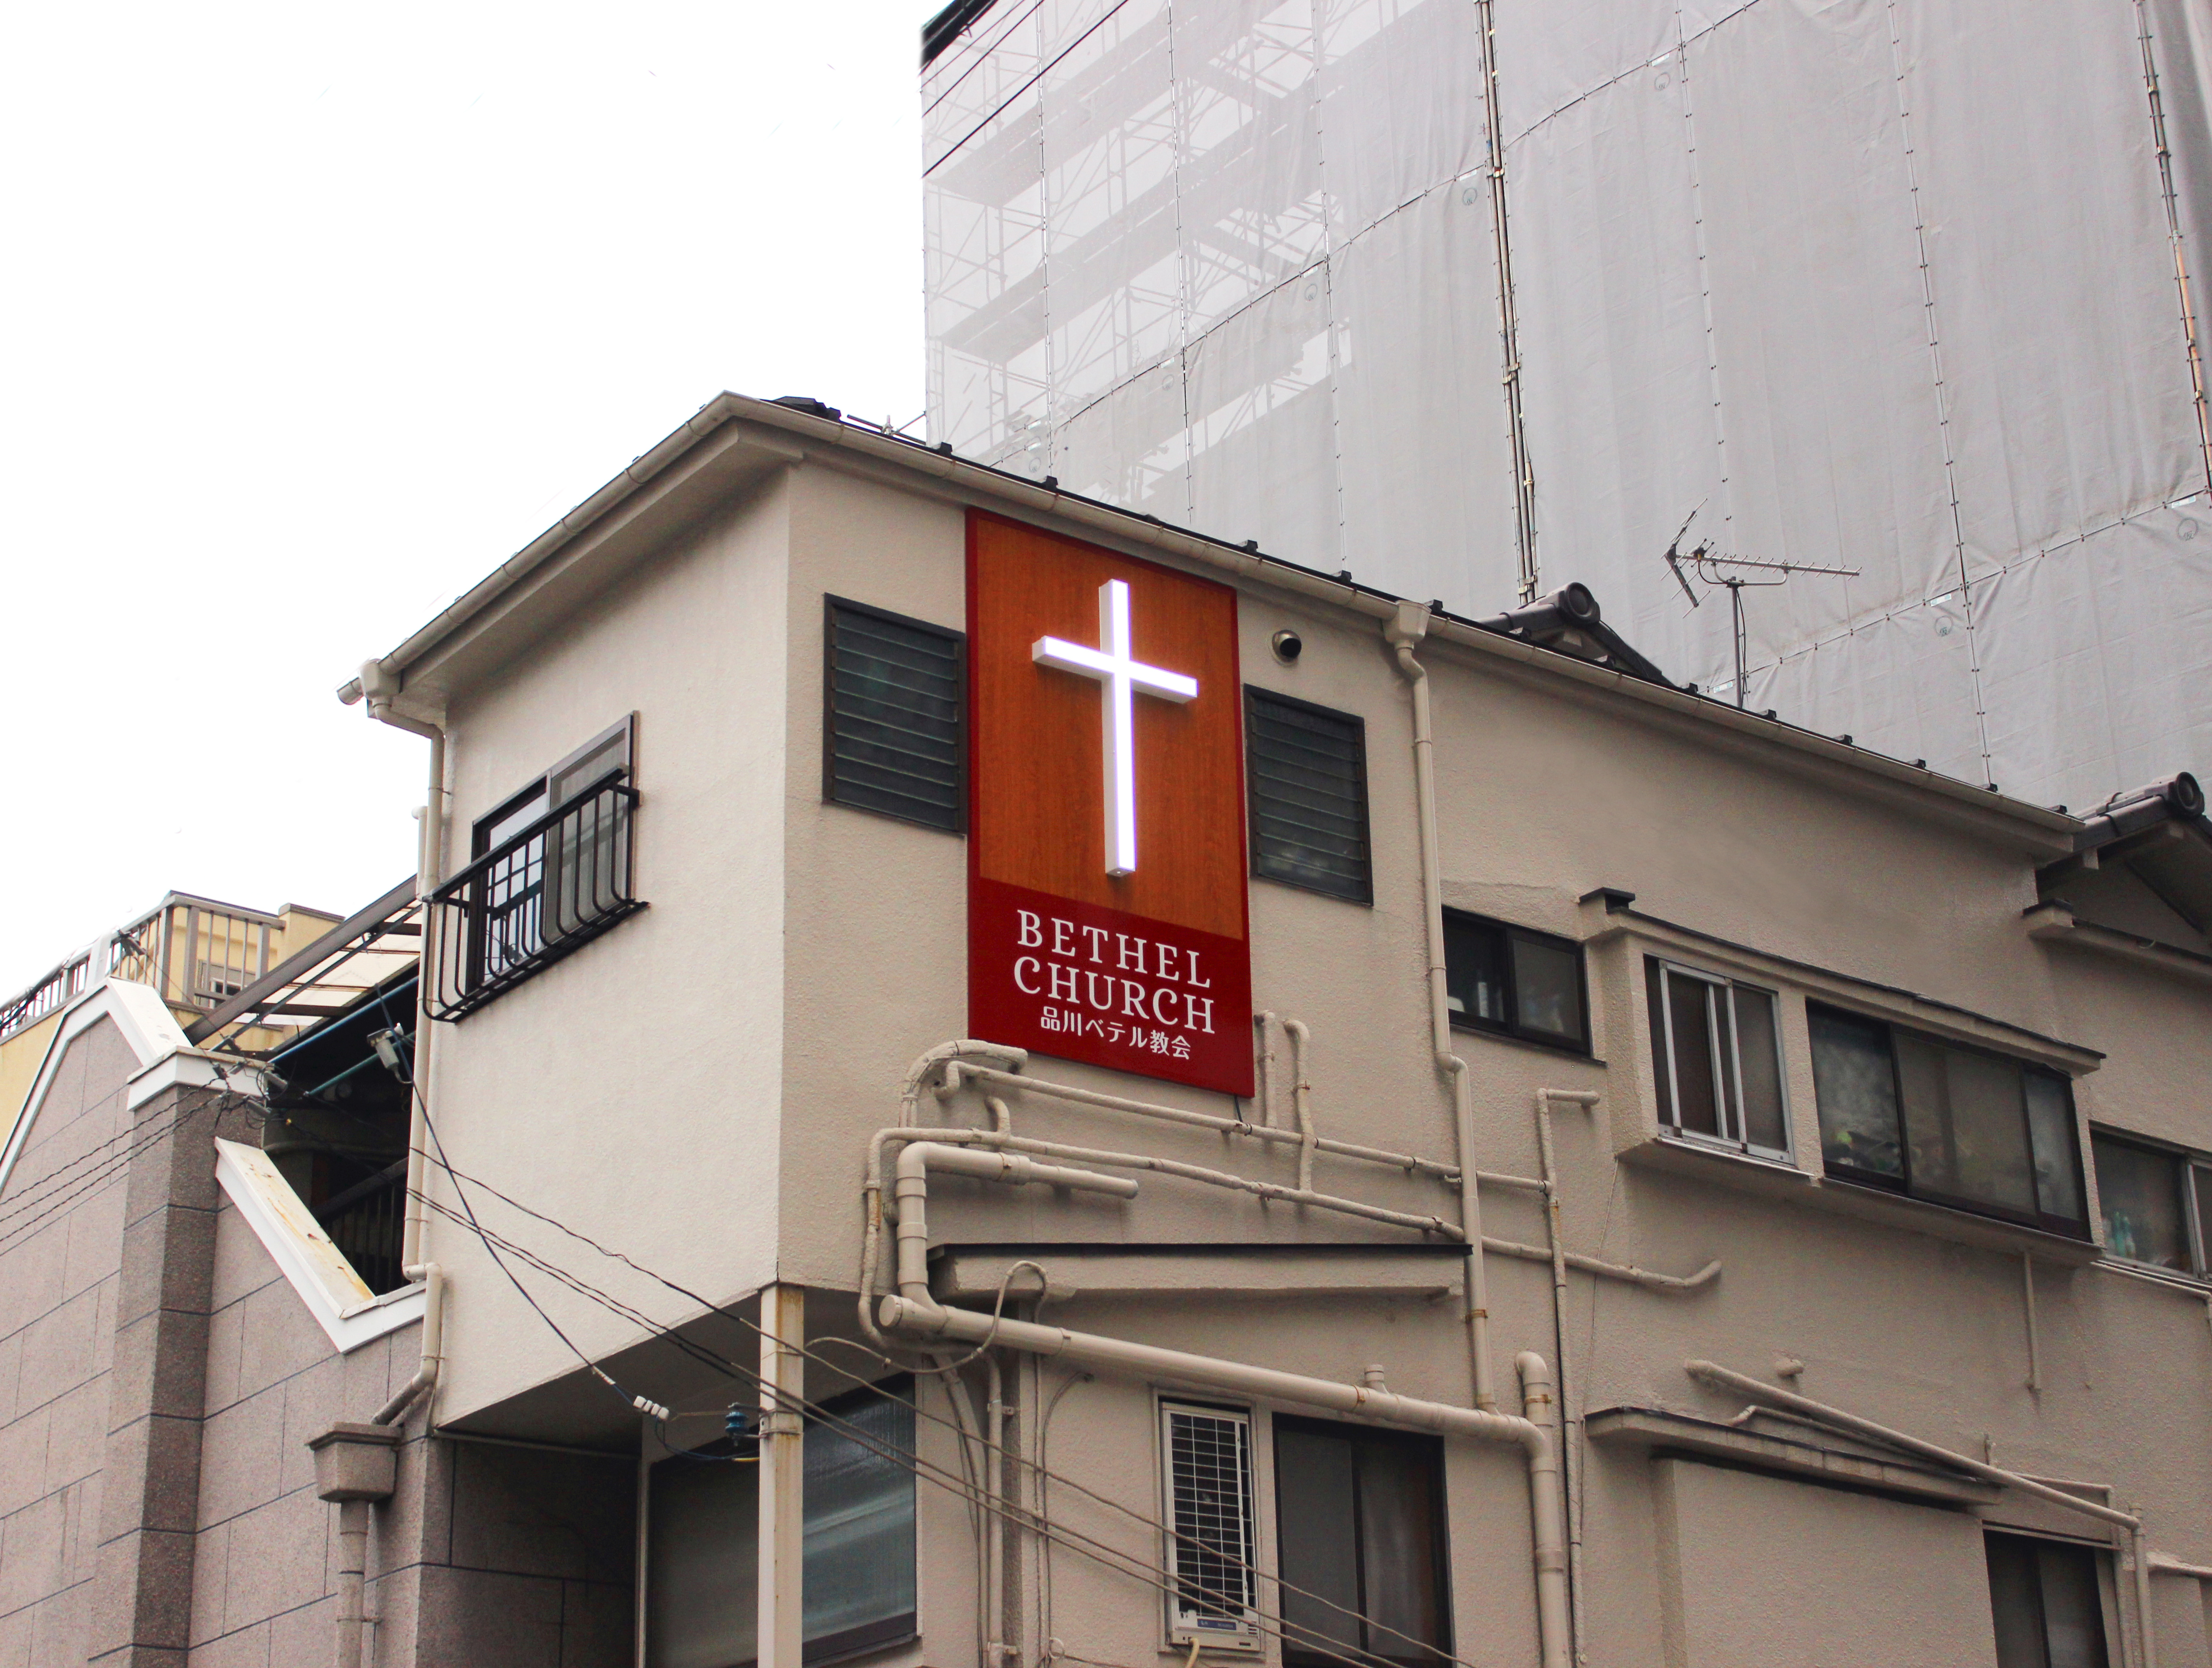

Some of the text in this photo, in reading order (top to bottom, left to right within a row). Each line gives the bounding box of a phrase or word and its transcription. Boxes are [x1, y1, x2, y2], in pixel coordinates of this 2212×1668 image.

[1017, 909, 1211, 988] BETHEL
[1013, 956, 1216, 1034] CHURCH
[1040, 1005, 1191, 1060] 品川ベテル教会
